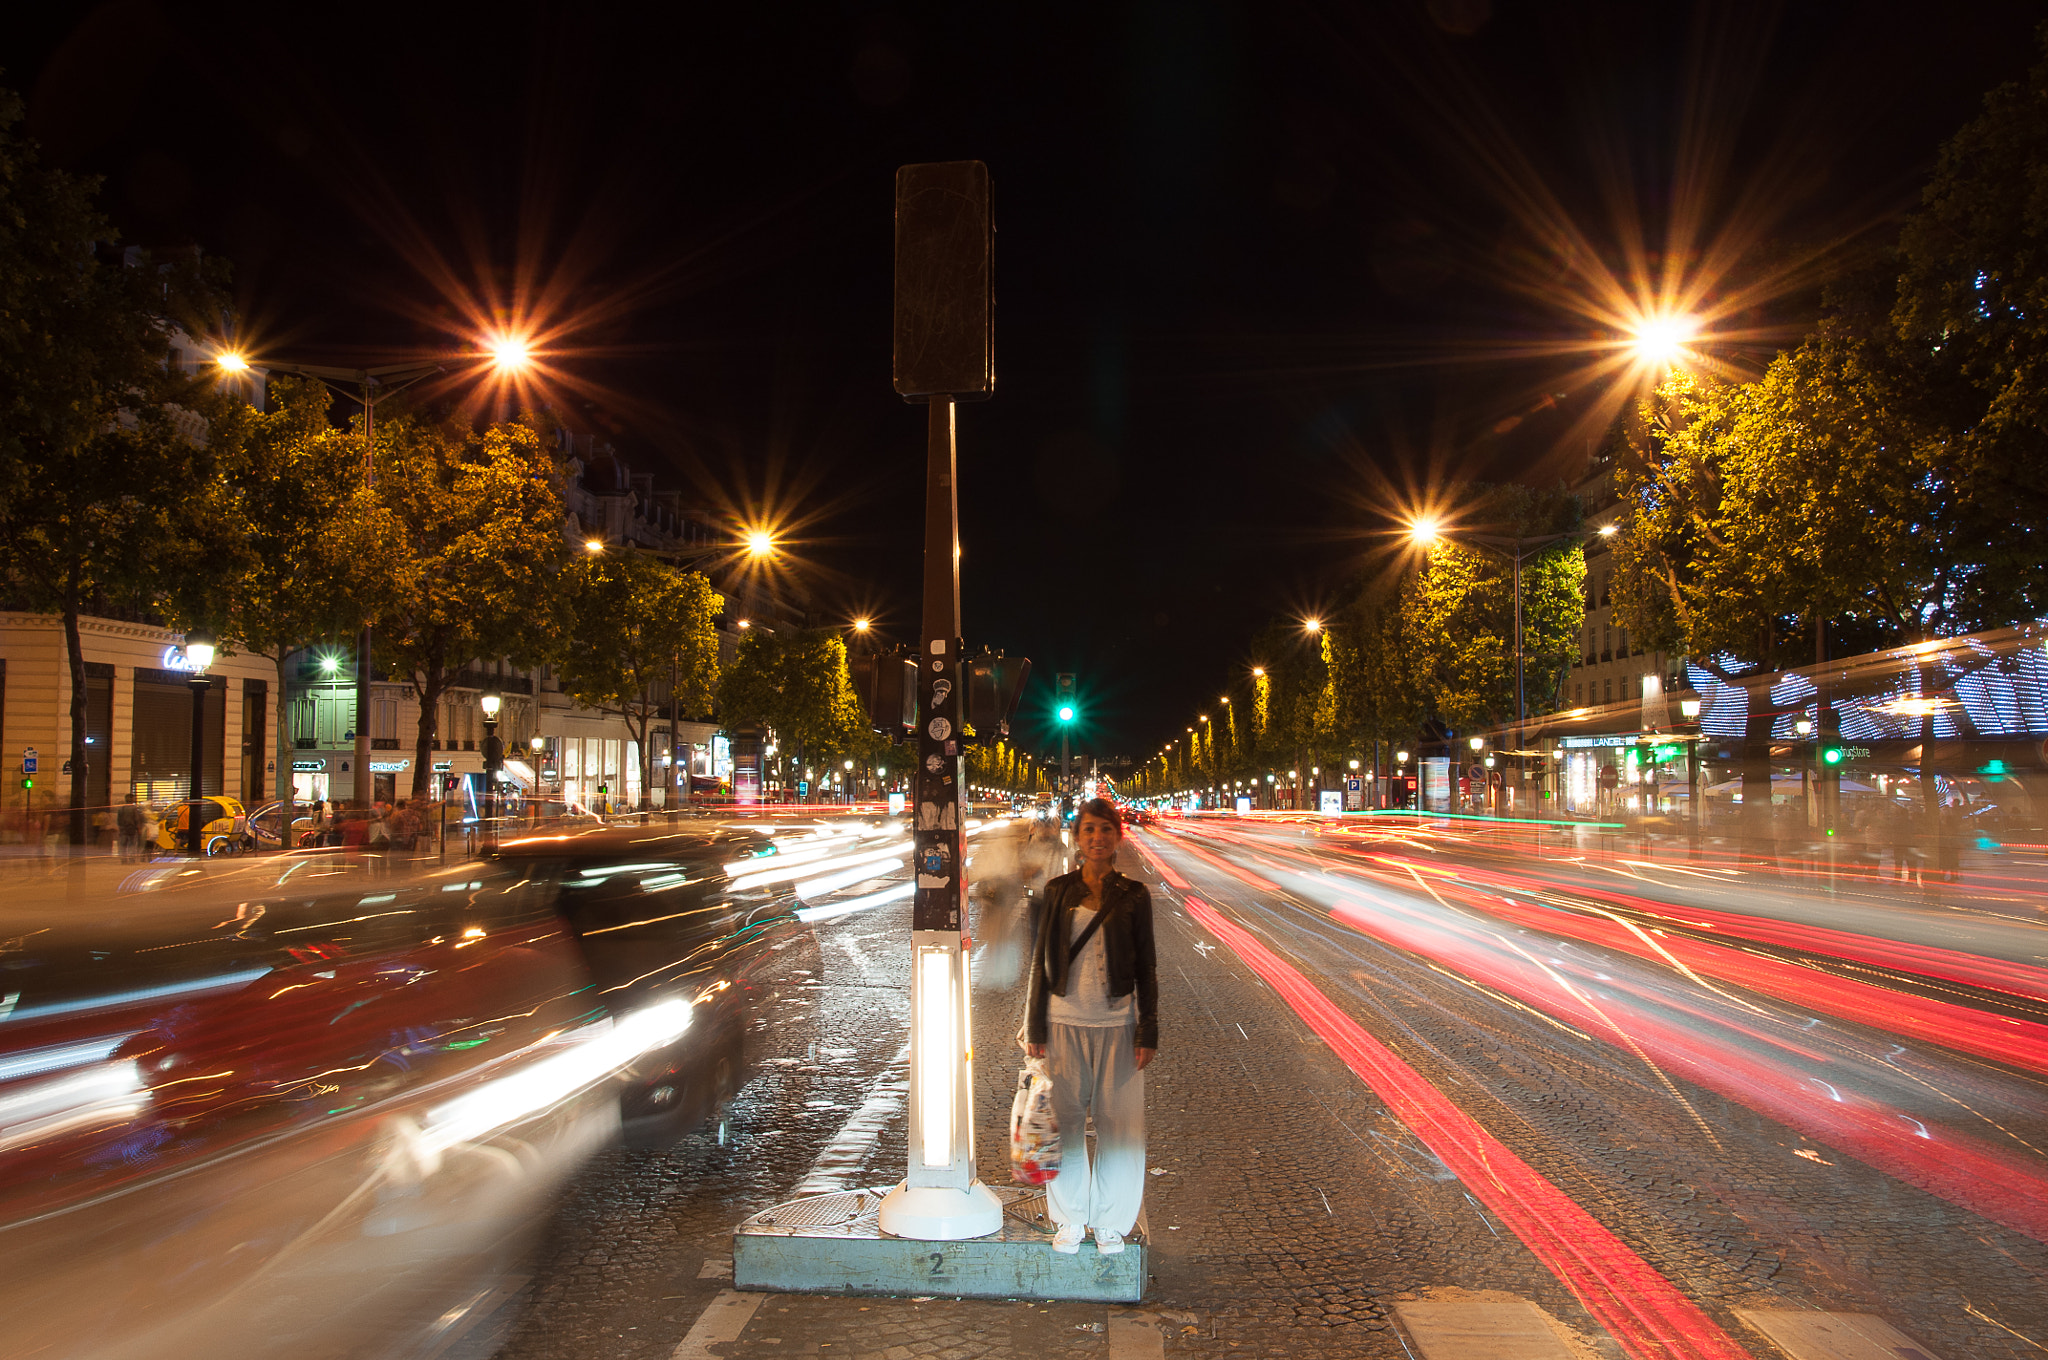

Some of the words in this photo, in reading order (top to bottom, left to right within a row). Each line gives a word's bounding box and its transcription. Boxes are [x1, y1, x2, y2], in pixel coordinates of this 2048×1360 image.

[1593, 738, 1625, 747] LANCEL
[369, 762, 404, 771] ONTBLANC
[929, 1252, 944, 1275] 2
